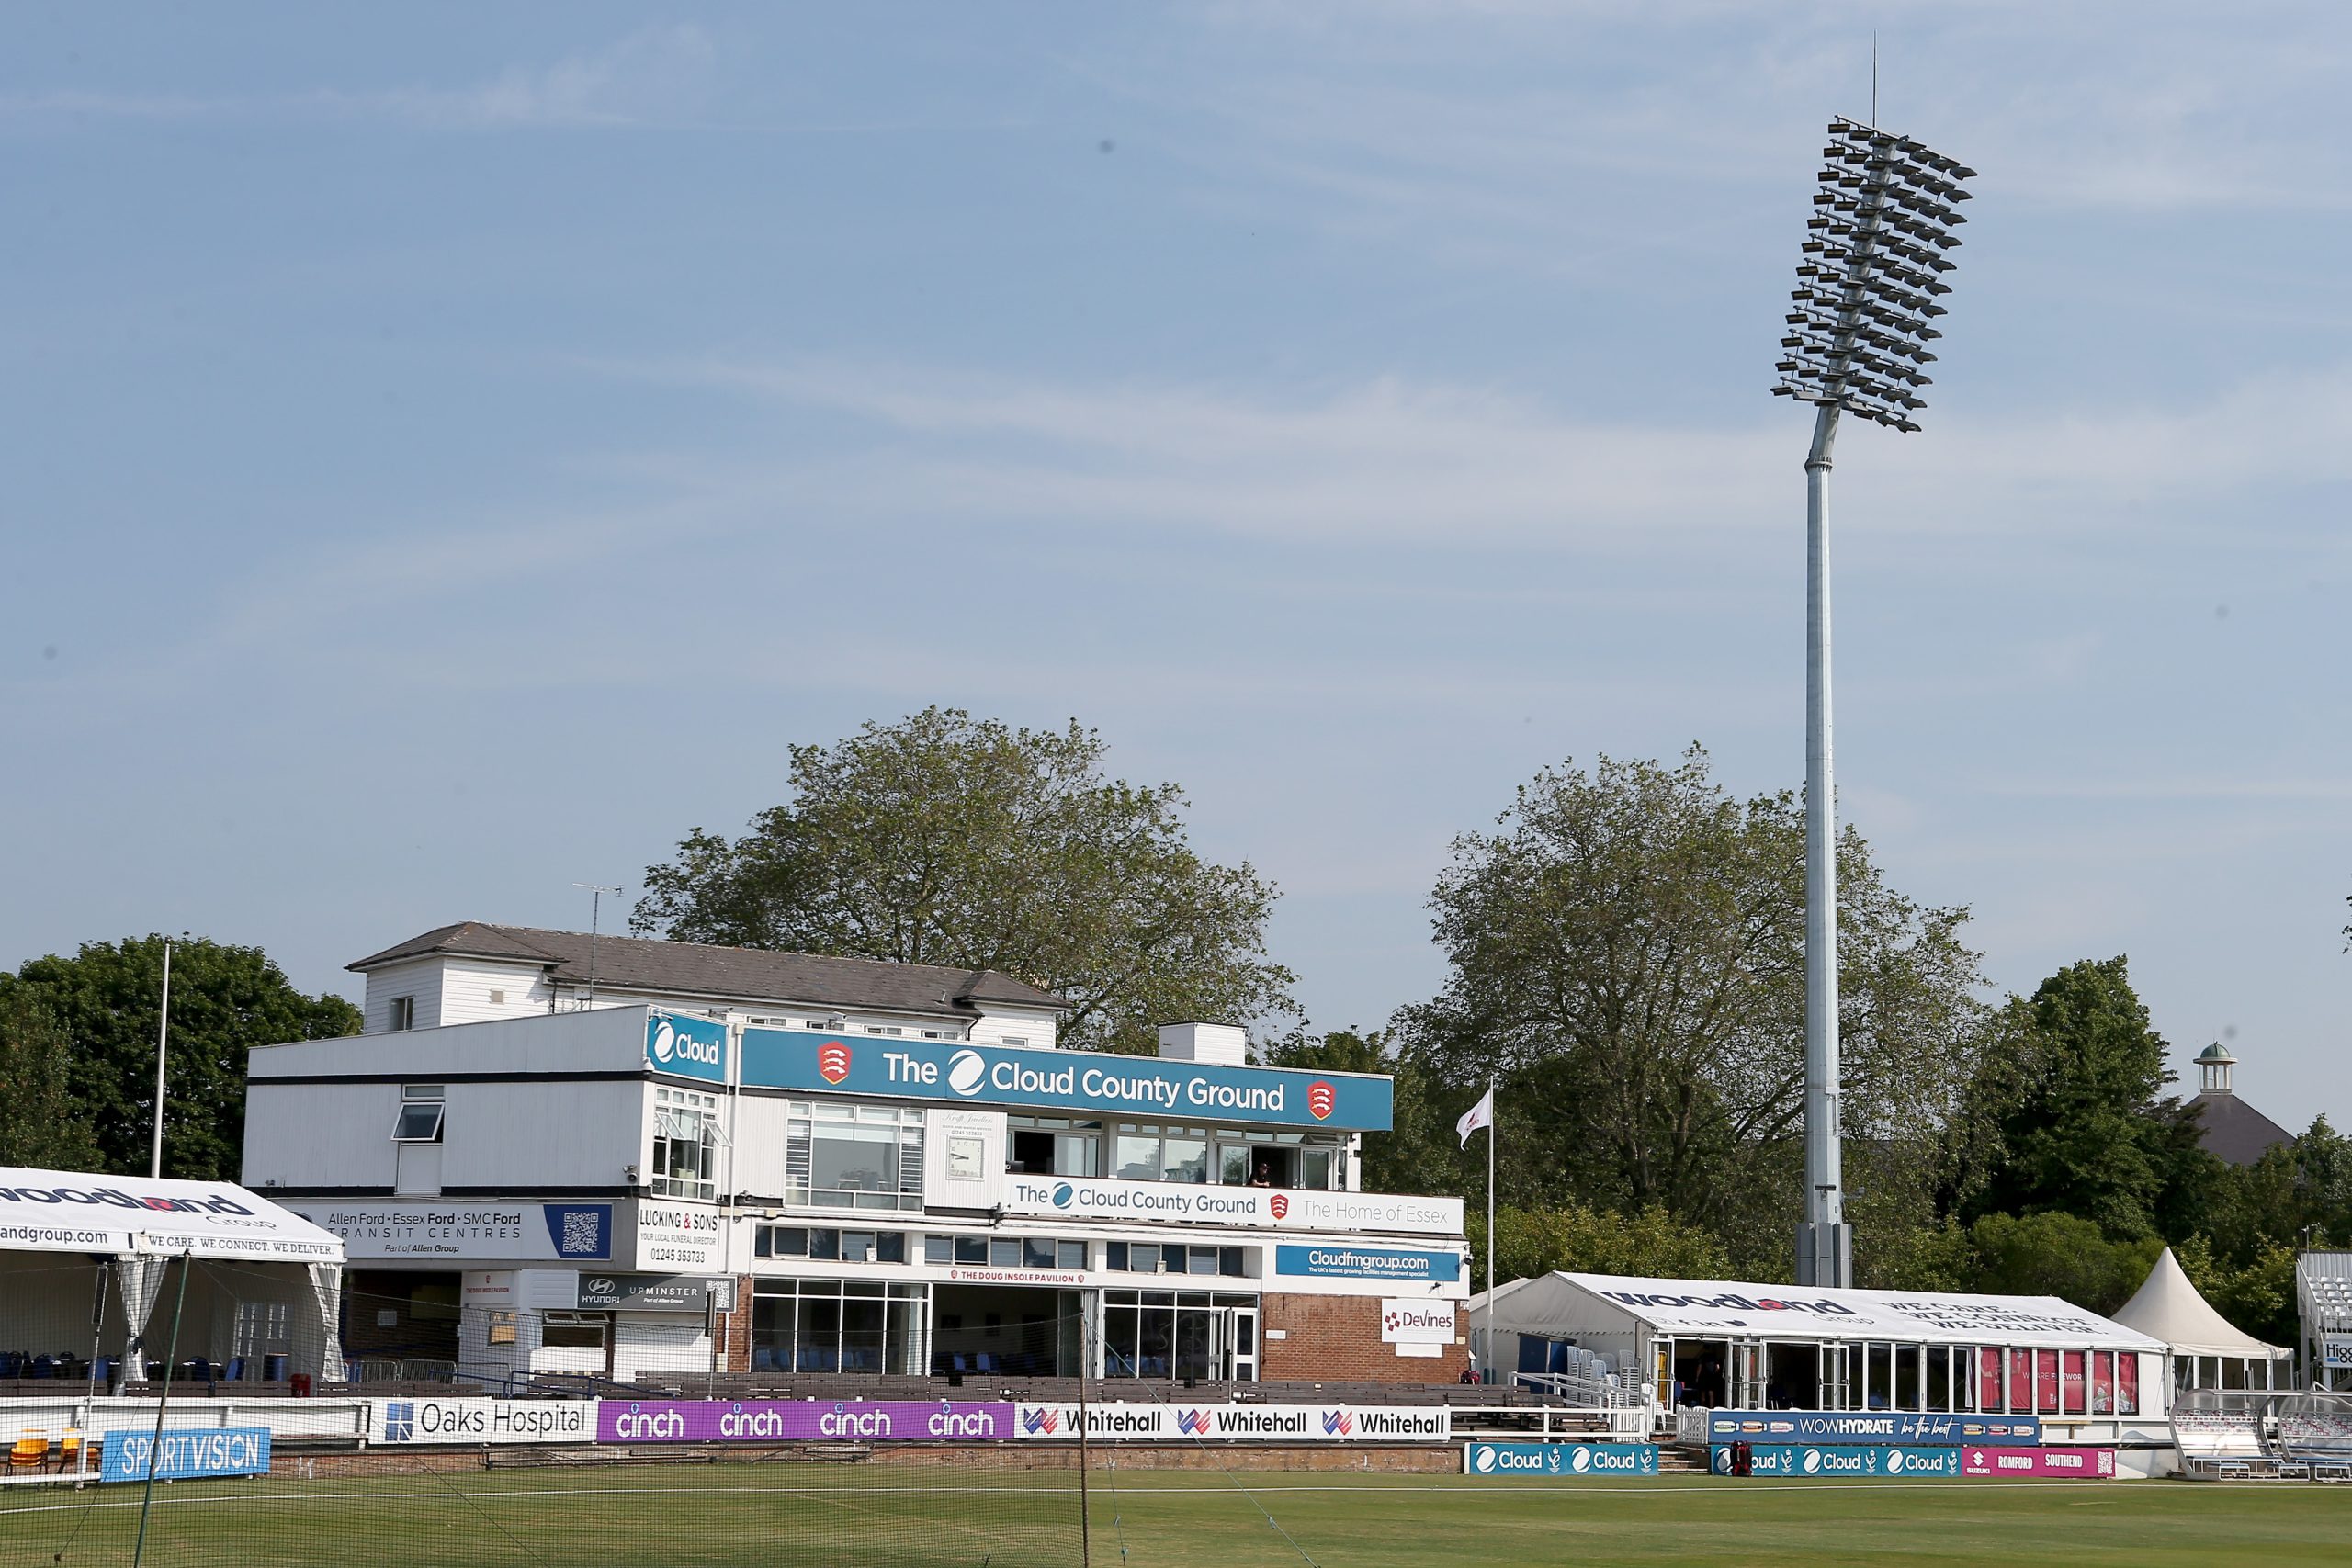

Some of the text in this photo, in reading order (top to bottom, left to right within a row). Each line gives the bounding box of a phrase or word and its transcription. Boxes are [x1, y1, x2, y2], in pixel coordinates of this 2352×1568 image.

[676, 1033, 718, 1065] Cloud
[883, 1053, 1284, 1111] The Cloud County Ground
[1016, 1185, 1256, 1214] The Cloud County Ground
[329, 1213, 521, 1224] Allen Ford Essex Ford SMC Ford
[639, 1209, 718, 1231] LUCKING & SONS
[1303, 1200, 1447, 1224] The Home of Essex
[206, 1215, 277, 1231] Group
[328, 1228, 521, 1238] TRANSIT CENTRES
[0, 1227, 107, 1244] andgroup.com
[149, 1235, 334, 1255] WE CARE. WE CONNECT. WE DELIVER.
[640, 1232, 717, 1246] YOUR LOCAL FUNERAL DIRECTOR
[385, 1244, 459, 1254] Part of Allen Group
[650, 1248, 706, 1263] 01245 353733
[1308, 1250, 1429, 1271] Cloudfmgroup.com
[961, 1271, 1074, 1282] THE DOUG INSOLE PAVILION
[582, 1295, 620, 1303] HYUNDAI
[629, 1286, 698, 1297] UPMINSTER
[1598, 1292, 1857, 1315] woodland
[1403, 1310, 1453, 1328] DeVines
[421, 1404, 585, 1438] Oaks Hospital
[616, 1403, 684, 1438] cinch
[720, 1403, 783, 1437] cinch
[820, 1404, 891, 1436] cinch
[928, 1404, 994, 1436] cinch
[1066, 1410, 1161, 1432] Whitehall
[1217, 1411, 1306, 1433] Whitehall
[1360, 1413, 1444, 1434] Whitehall
[1901, 1416, 1915, 1434] be
[1932, 1416, 1960, 1439] best
[1498, 1450, 1543, 1470] Cloud
[1593, 1451, 1635, 1470] Cloud
[1751, 1453, 1777, 1469] oud
[1824, 1453, 1860, 1470] Cloud
[1905, 1454, 1943, 1471] Cloud
[1998, 1455, 2033, 1471] ROMFORD
[2045, 1453, 2083, 1468] SOUTHEND
